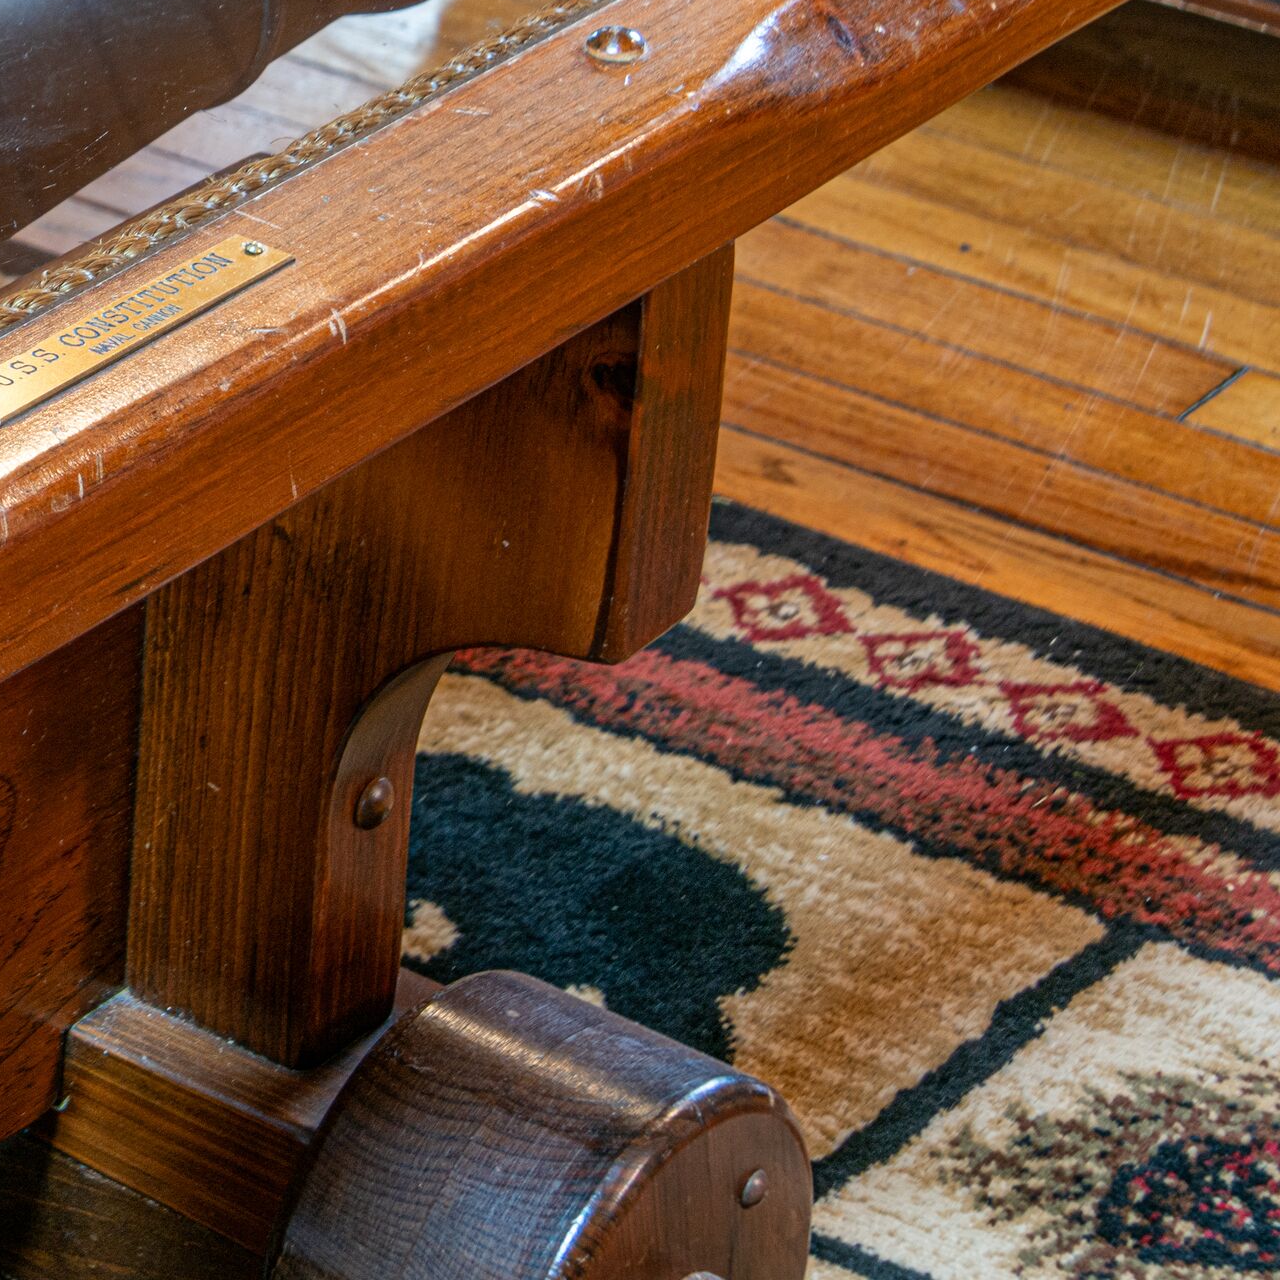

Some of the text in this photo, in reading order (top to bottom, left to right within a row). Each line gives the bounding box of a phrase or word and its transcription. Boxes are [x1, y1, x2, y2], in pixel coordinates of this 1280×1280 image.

[59, 252, 233, 347] CONSTITUTION
[89, 303, 183, 355] NAVAL CANNON
